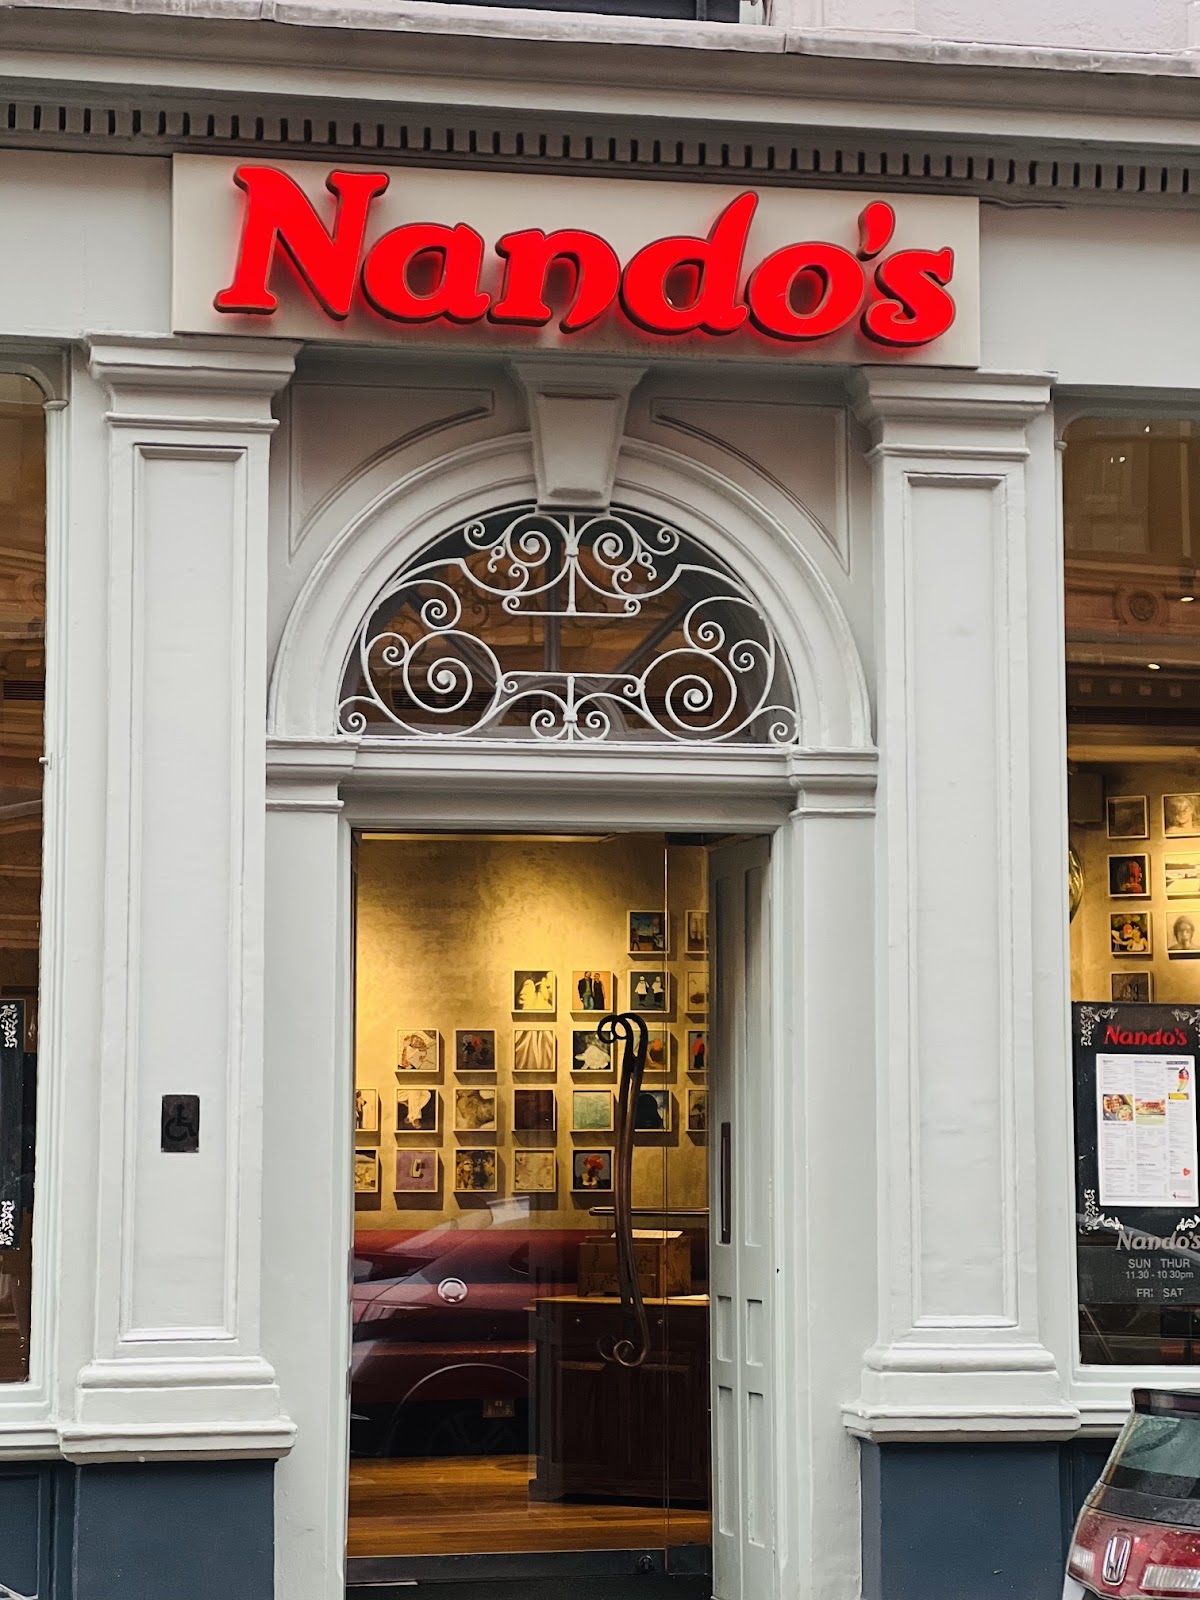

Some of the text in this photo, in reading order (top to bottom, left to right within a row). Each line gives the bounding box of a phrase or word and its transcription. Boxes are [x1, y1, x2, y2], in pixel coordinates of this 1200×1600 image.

[214, 163, 956, 346] Nando's
[1104, 1025, 1187, 1046] Nando's
[1116, 1230, 1200, 1251] Nando's
[1128, 1258, 1190, 1269] SUN THUR
[1163, 1288, 1184, 1298] SAT
